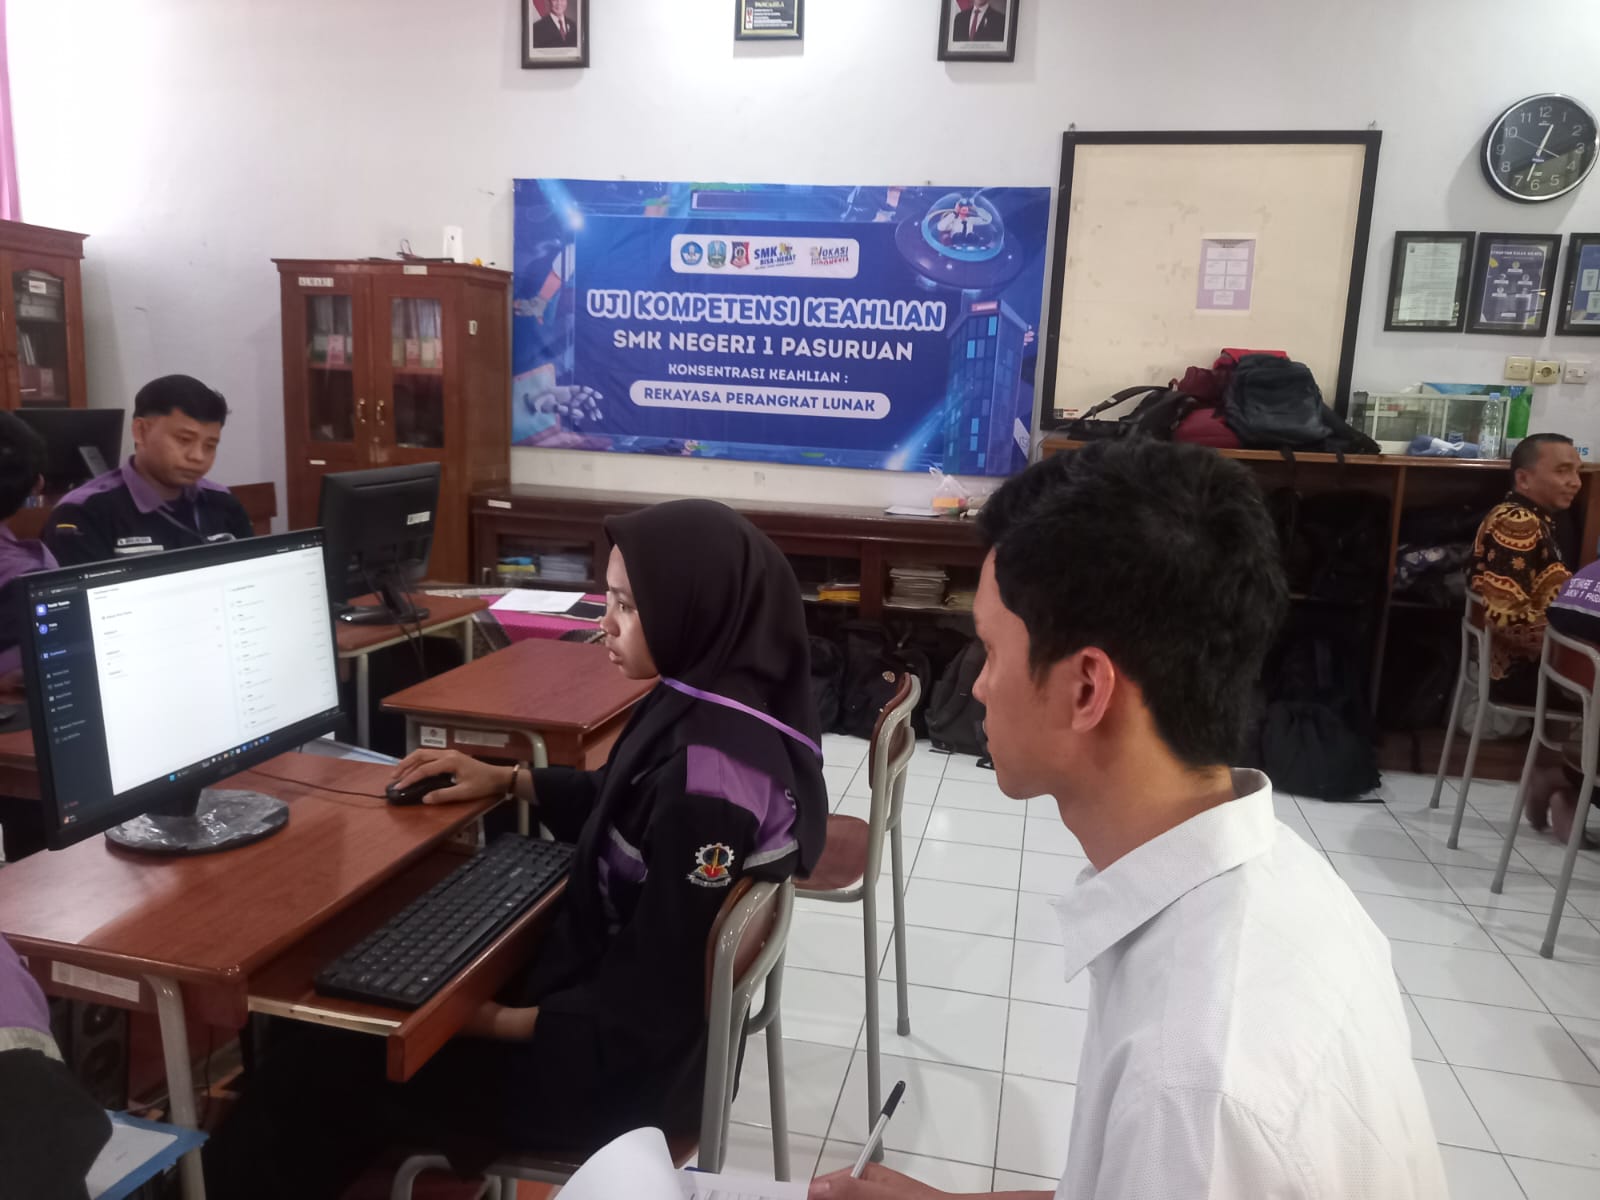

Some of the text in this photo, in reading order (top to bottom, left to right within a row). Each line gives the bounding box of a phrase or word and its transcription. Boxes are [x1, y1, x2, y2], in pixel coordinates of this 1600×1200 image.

[1520, 112, 1532, 123] 11
[1539, 105, 1552, 118] 12
[1562, 111, 1567, 122] 1
[1504, 126, 1518, 138] 10
[1571, 124, 1583, 136] 2
[1496, 143, 1506, 155] 9
[1575, 142, 1585, 154] 3
[1501, 161, 1511, 173] 8
[1566, 160, 1576, 171] 4
[1514, 175, 1523, 186] 7
[1530, 178, 1540, 190] 6
[1550, 174, 1560, 186] 5
[754, 246, 778, 260] SMK
[588, 290, 946, 331] UJI KOMPETENSI KEAHLIAN
[613, 329, 913, 361] SMK NEGERI 1 PASURUAN
[668, 363, 765, 380] KONSENTRASI
[769, 368, 840, 383] KEAHLIAN
[644, 387, 875, 412] REKAYASA PERANGKAT LUNAK
